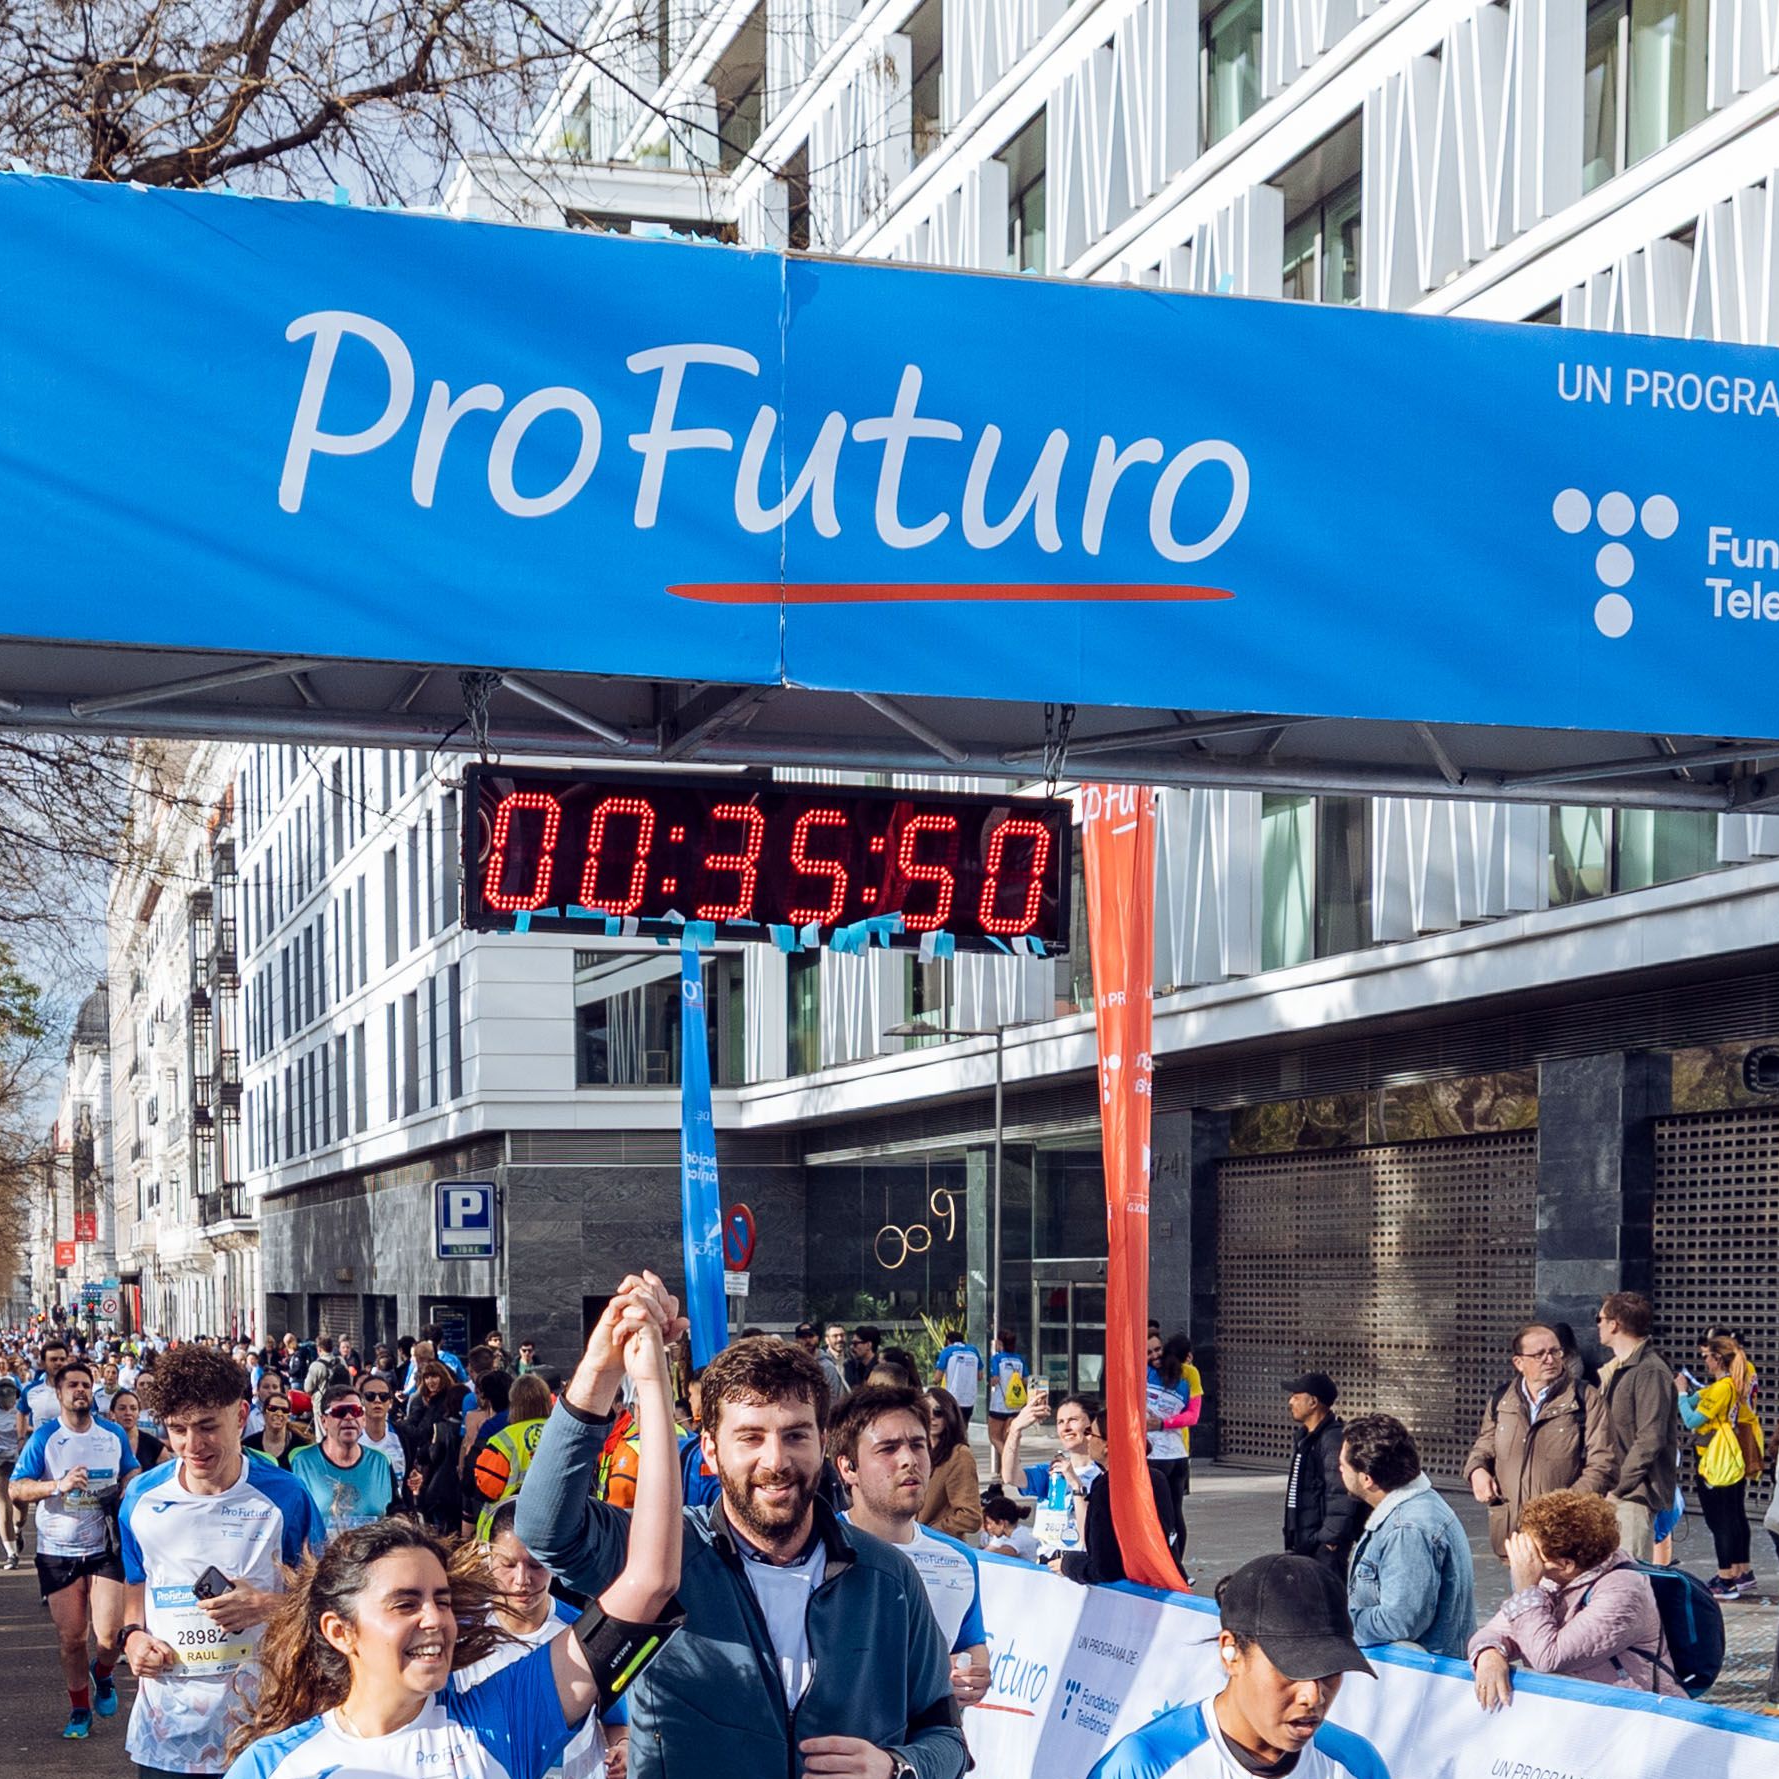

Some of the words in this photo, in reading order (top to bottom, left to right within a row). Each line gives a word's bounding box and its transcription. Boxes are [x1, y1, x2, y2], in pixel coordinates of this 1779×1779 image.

[1558, 363, 1612, 404] UN
[279, 310, 1249, 563] ProFuturo
[484, 791, 1053, 935] 00:35:50
[449, 1190, 483, 1228] P
[178, 1629, 228, 1646] 28982
[1078, 1635, 1090, 1650] UN
[1089, 1638, 1127, 1663] PROGRAMA
[1080, 1688, 1120, 1717] Fundación
[1075, 1708, 1112, 1737] Telefónica
[1491, 1757, 1513, 1777] UN
